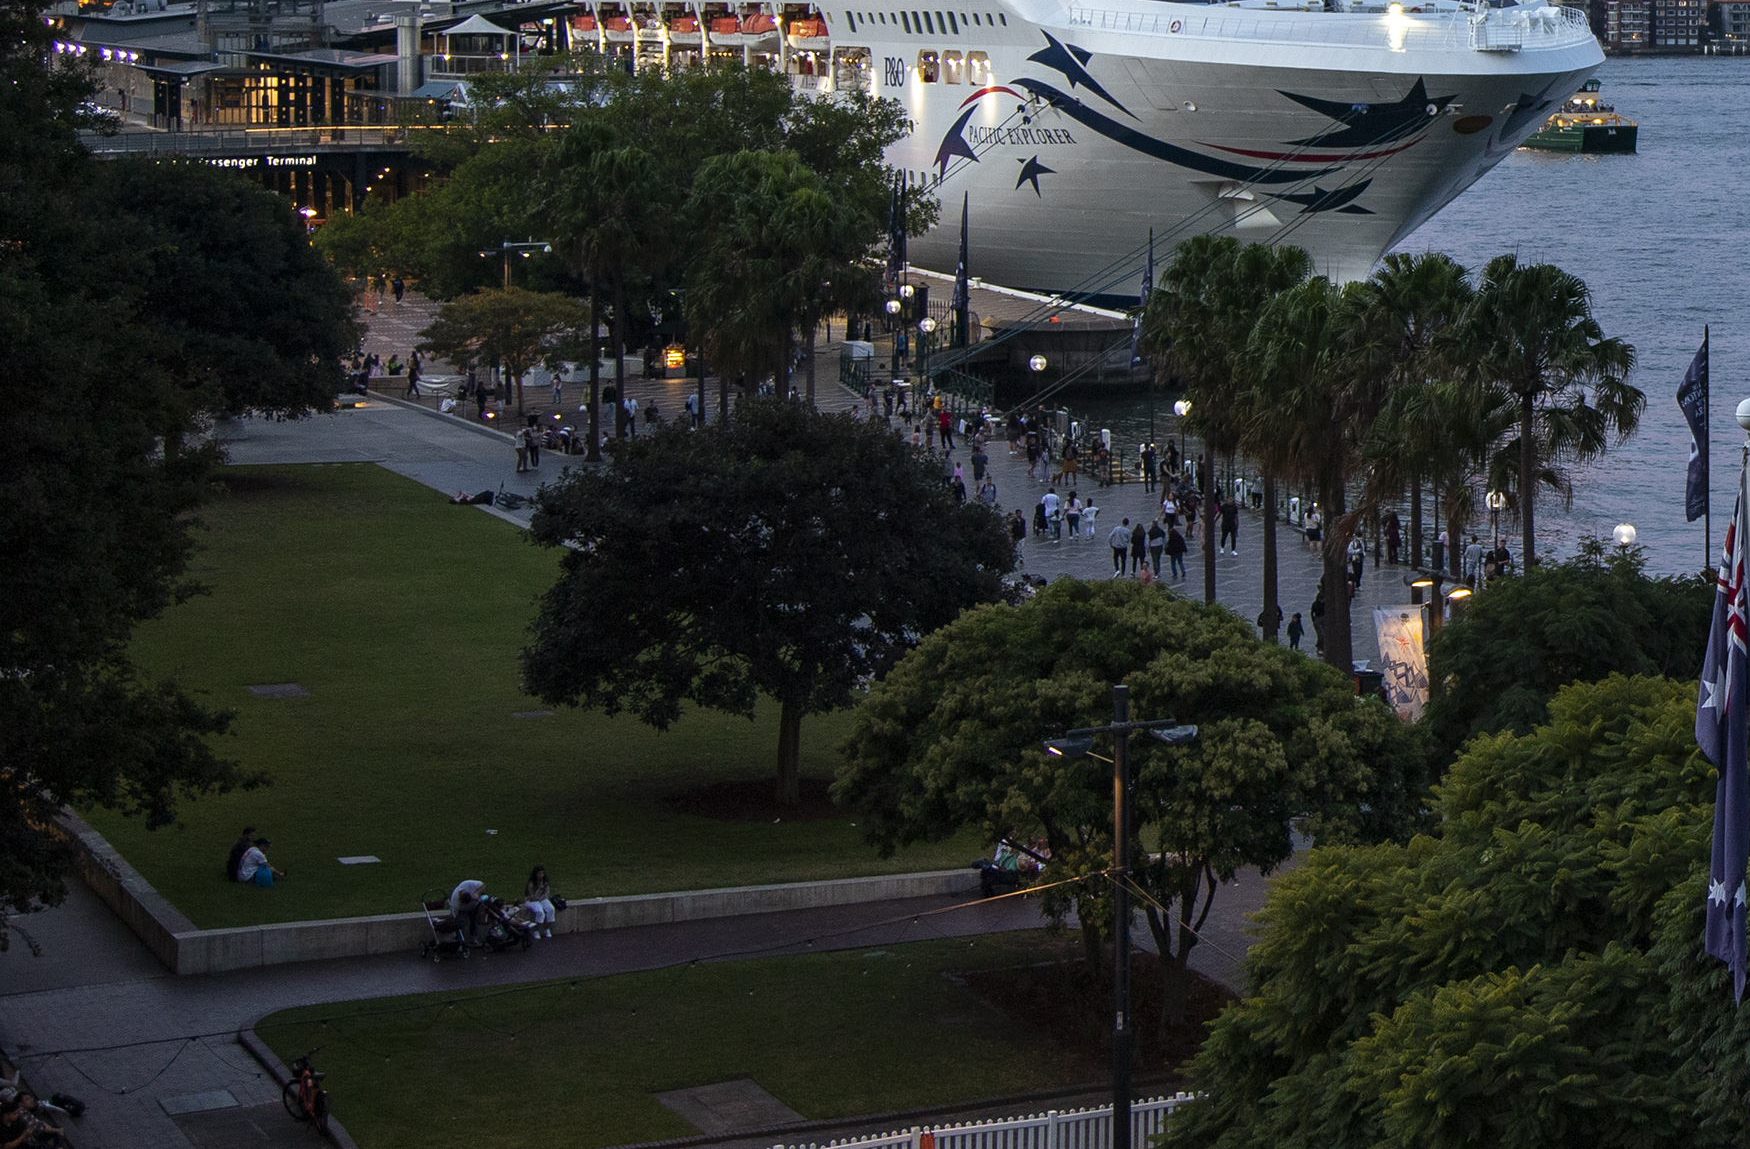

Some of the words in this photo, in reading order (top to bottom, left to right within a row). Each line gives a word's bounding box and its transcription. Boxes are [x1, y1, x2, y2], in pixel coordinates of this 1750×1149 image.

[884, 57, 905, 87] P&O
[969, 125, 1006, 145] PACIFIC
[1007, 127, 1077, 145] EXPLORER
[266, 155, 317, 167] Terminal
